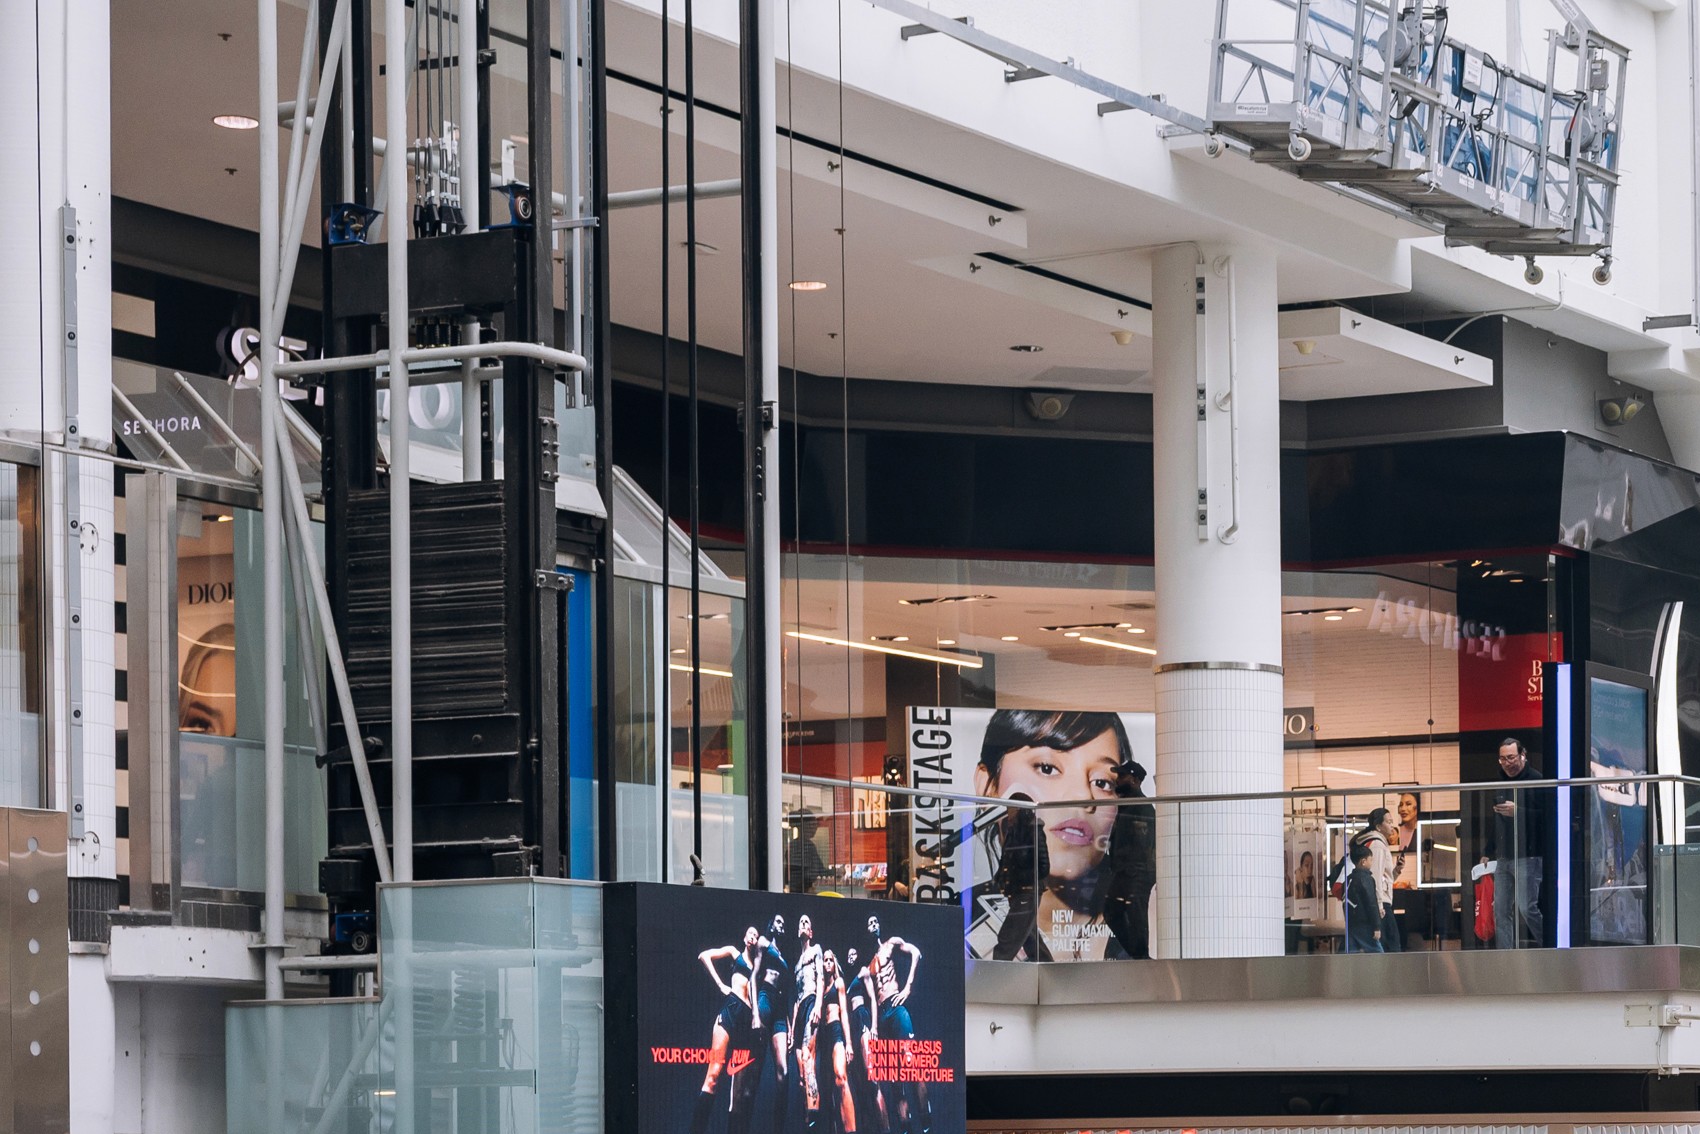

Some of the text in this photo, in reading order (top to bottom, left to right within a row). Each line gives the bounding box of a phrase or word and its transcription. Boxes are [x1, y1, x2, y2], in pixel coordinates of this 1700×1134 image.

[911, 706, 953, 904] BACKSTAGE
[1051, 909, 1074, 923] NEW
[1052, 924, 1079, 938] GLOW
[1052, 938, 1091, 952] PALETTE
[867, 1039, 943, 1054] RUN IN PEGASUS
[651, 1047, 682, 1063] YOUR
[732, 1050, 750, 1064] RUN
[867, 1054, 939, 1068] RUN IN VOMERO
[867, 1067, 954, 1082] RUN IN STRUCTURE
